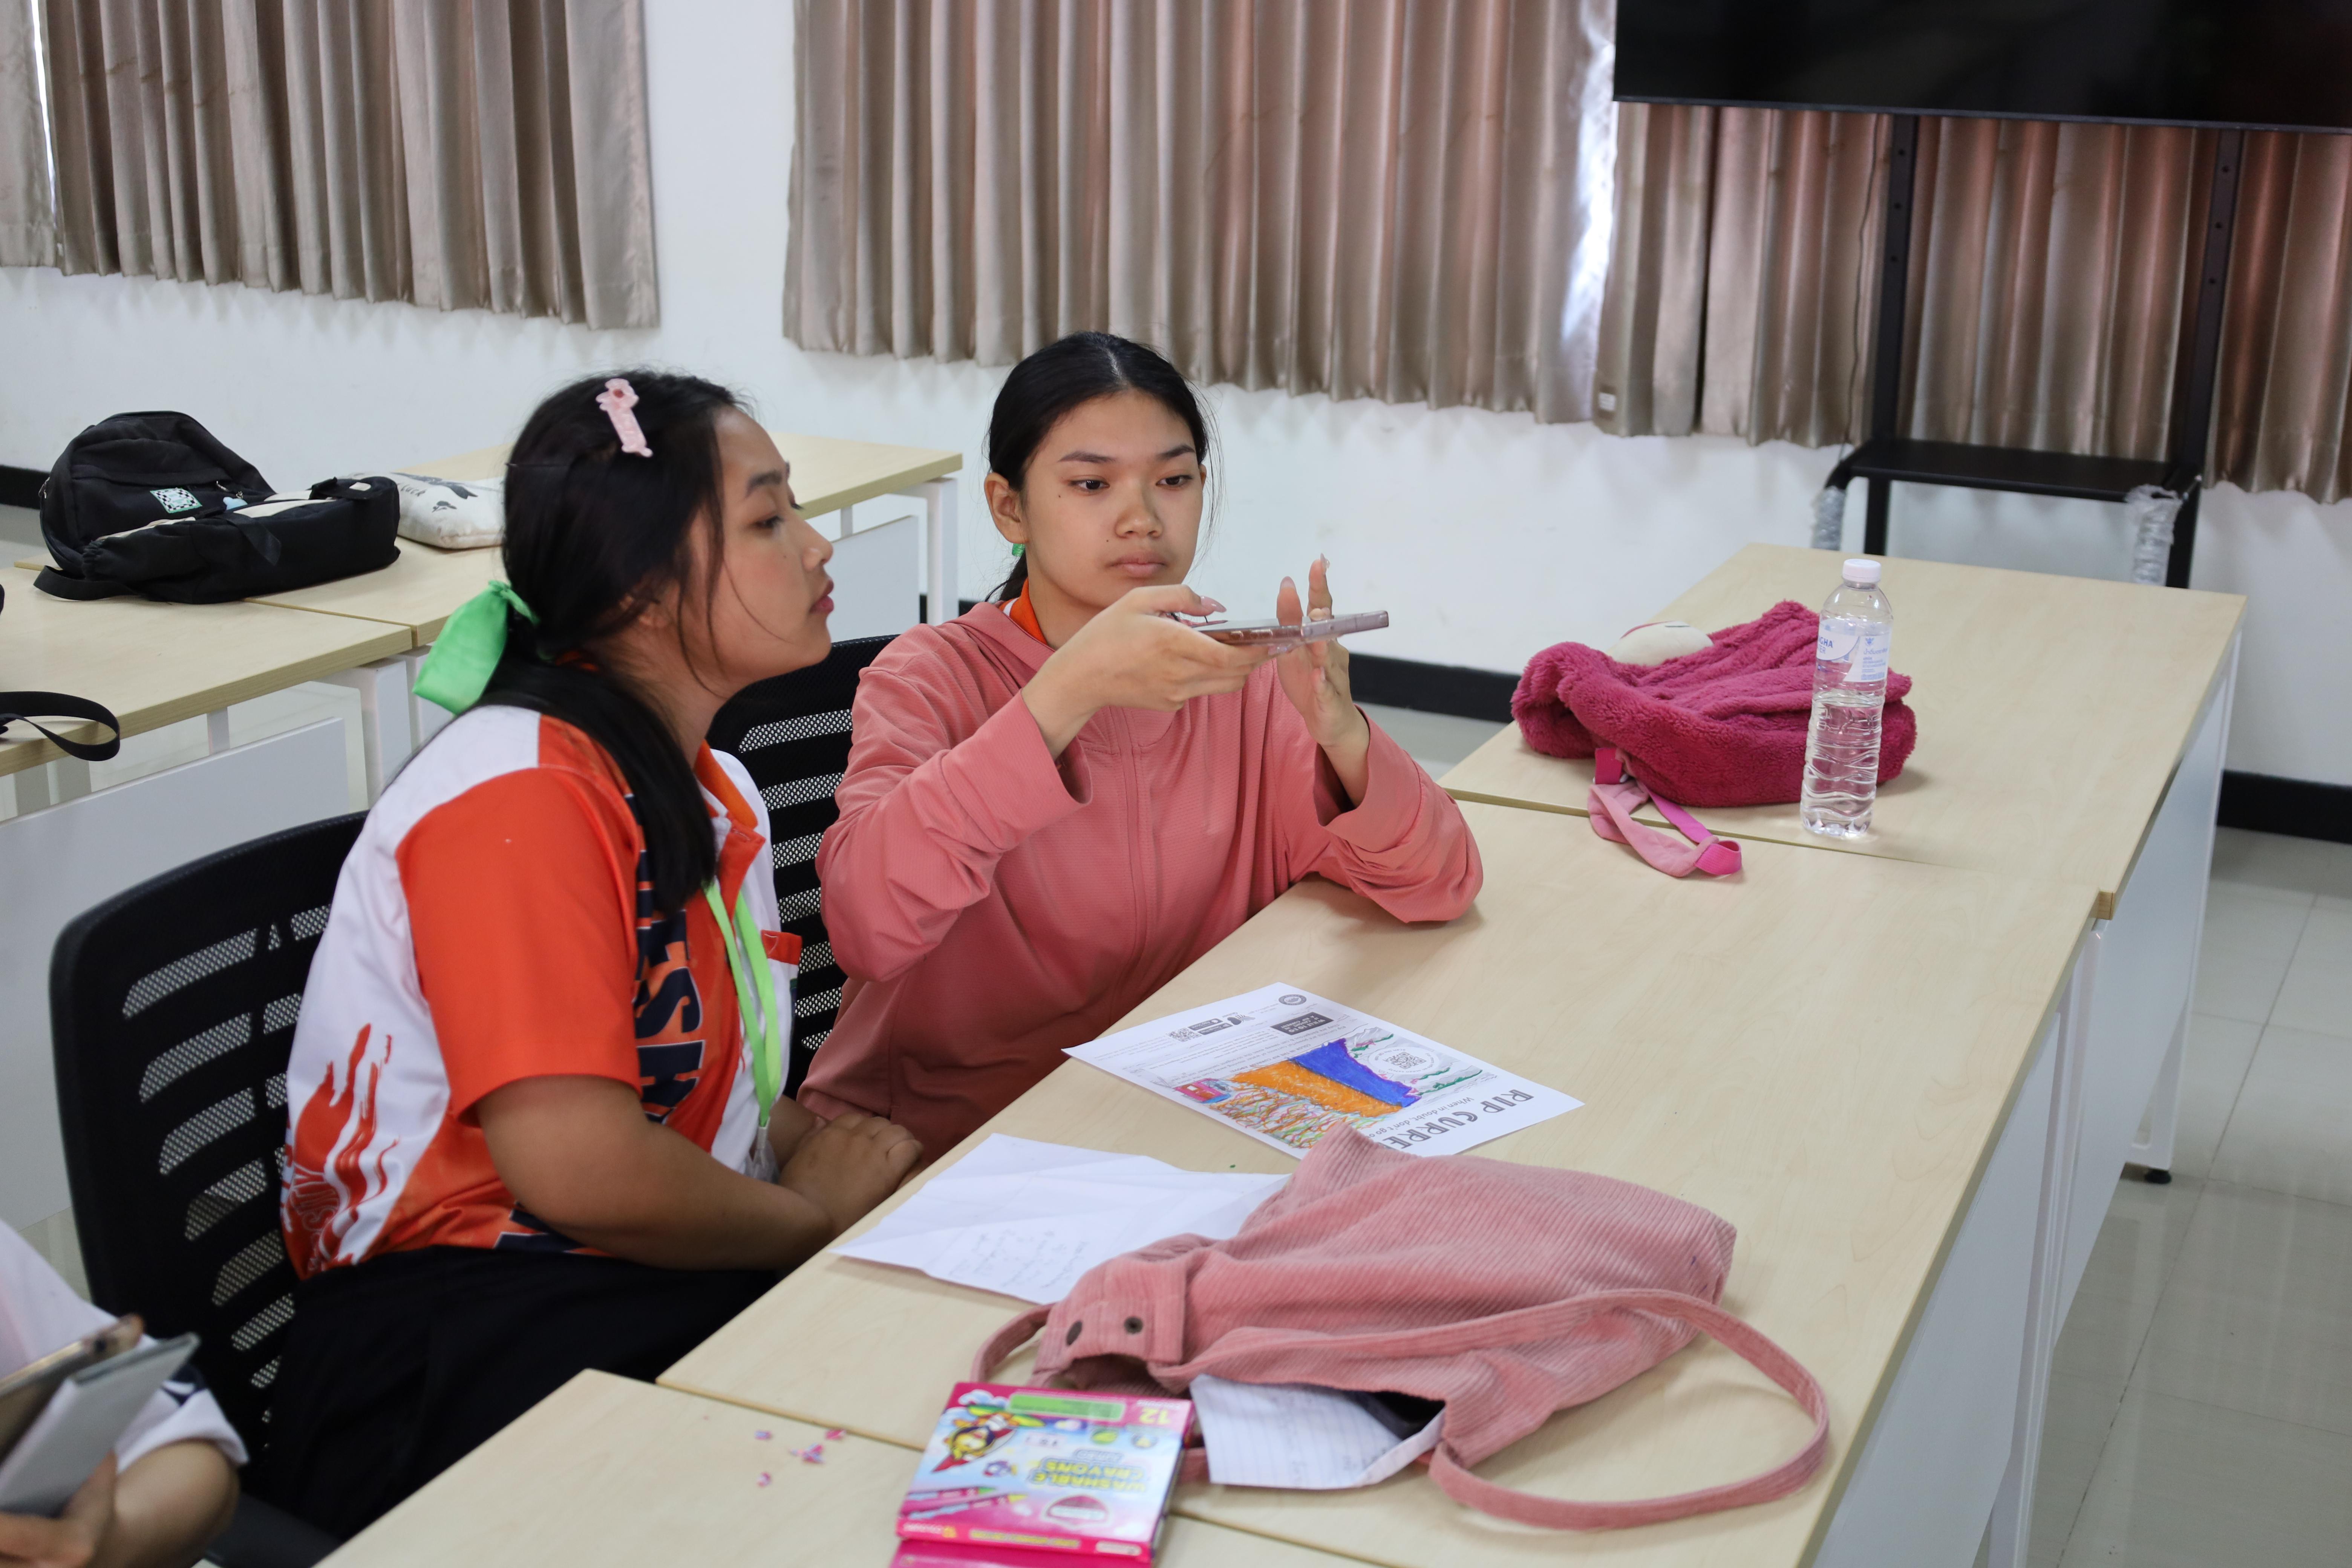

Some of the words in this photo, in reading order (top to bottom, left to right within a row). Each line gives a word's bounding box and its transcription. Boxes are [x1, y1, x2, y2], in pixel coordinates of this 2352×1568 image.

[1819, 636, 1833, 648] GHA
[1449, 1097, 1473, 1107] When
[1481, 1090, 1533, 1113] RIP
[1410, 1110, 1438, 1121] doubt,
[1388, 1120, 1410, 1131] don't
[1139, 1409, 1169, 1424] 12
[1045, 1462, 1143, 1478] CRAYONS
[1033, 1473, 1144, 1490] WASHABLE
